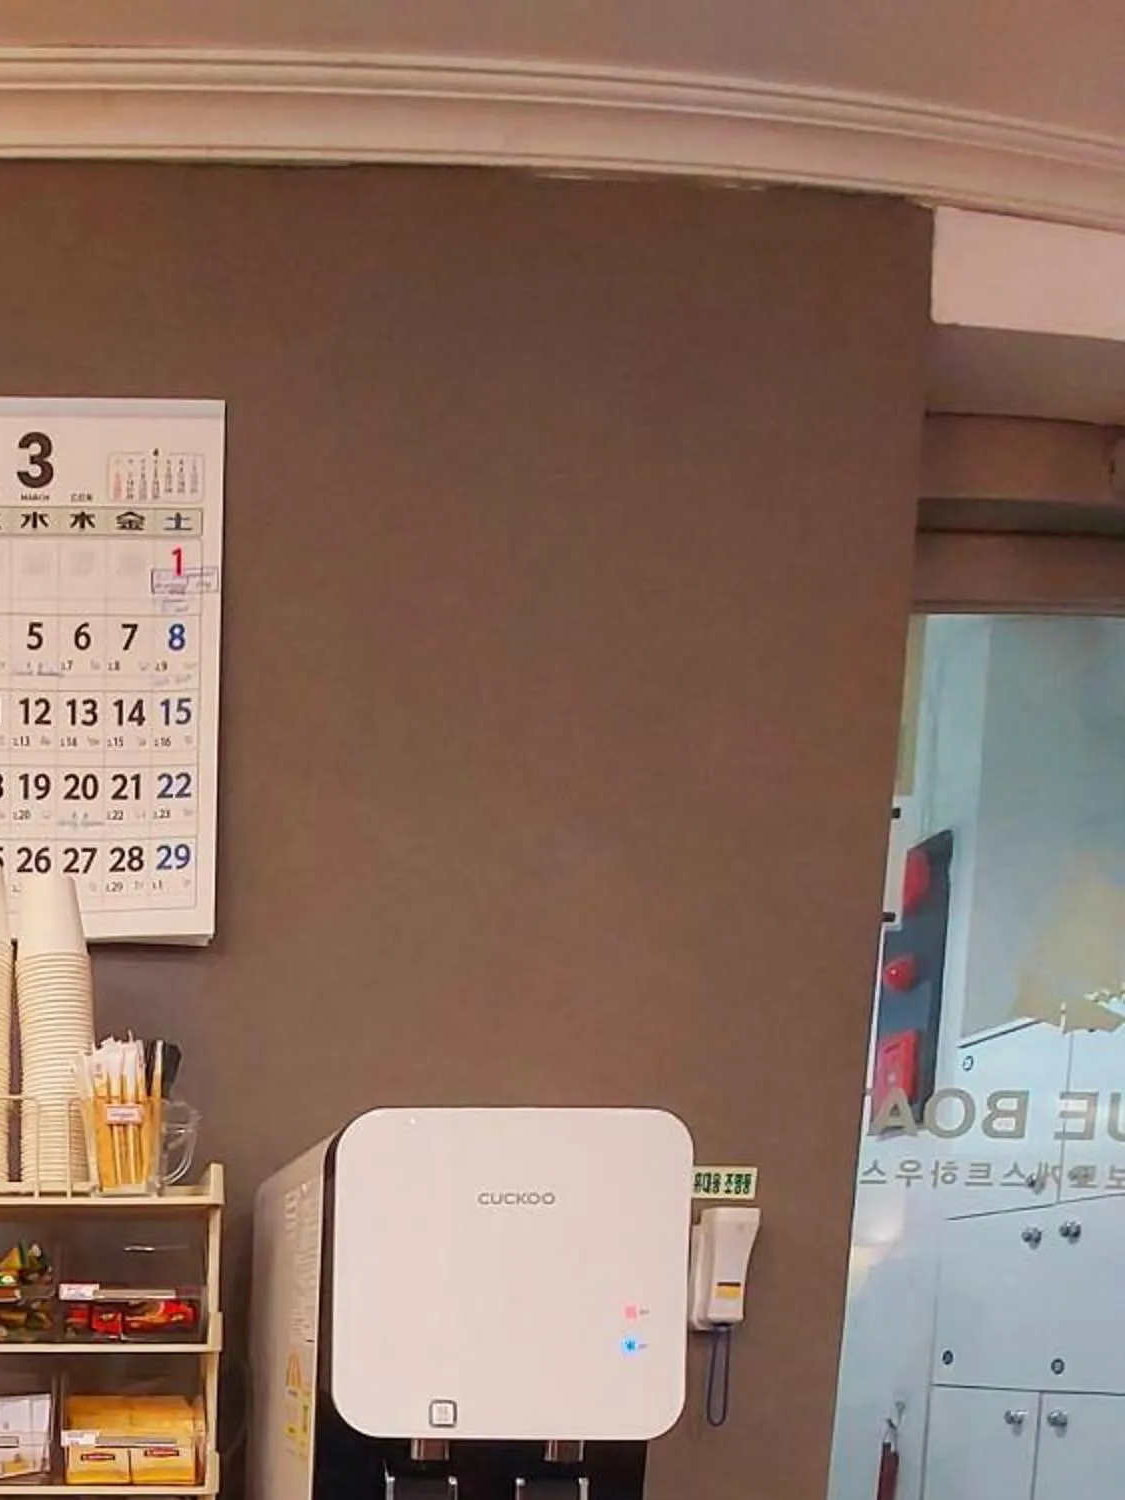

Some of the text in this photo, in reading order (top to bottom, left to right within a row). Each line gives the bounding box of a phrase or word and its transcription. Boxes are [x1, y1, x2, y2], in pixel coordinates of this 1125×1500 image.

[17, 432, 53, 488] 3
[21, 511, 49, 529] 水
[70, 511, 95, 529] 木
[116, 511, 145, 531] 金
[163, 512, 192, 531] 土
[172, 547, 182, 577] 1
[26, 622, 43, 649] 5
[74, 622, 91, 650] 6
[122, 623, 138, 650] 7
[168, 623, 185, 651] 8
[19, 697, 51, 725] 12
[66, 698, 98, 726] 13
[113, 698, 145, 726] 14
[160, 698, 192, 725] 15
[18, 773, 51, 800] 19
[63, 773, 99, 800] 20
[111, 773, 141, 800] 21
[157, 772, 192, 799] 22
[16, 846, 51, 874] 26
[63, 847, 97, 874] 27
[109, 845, 144, 872] 28
[156, 843, 191, 870] 29
[478, 1192, 555, 1205] CUCKOO
